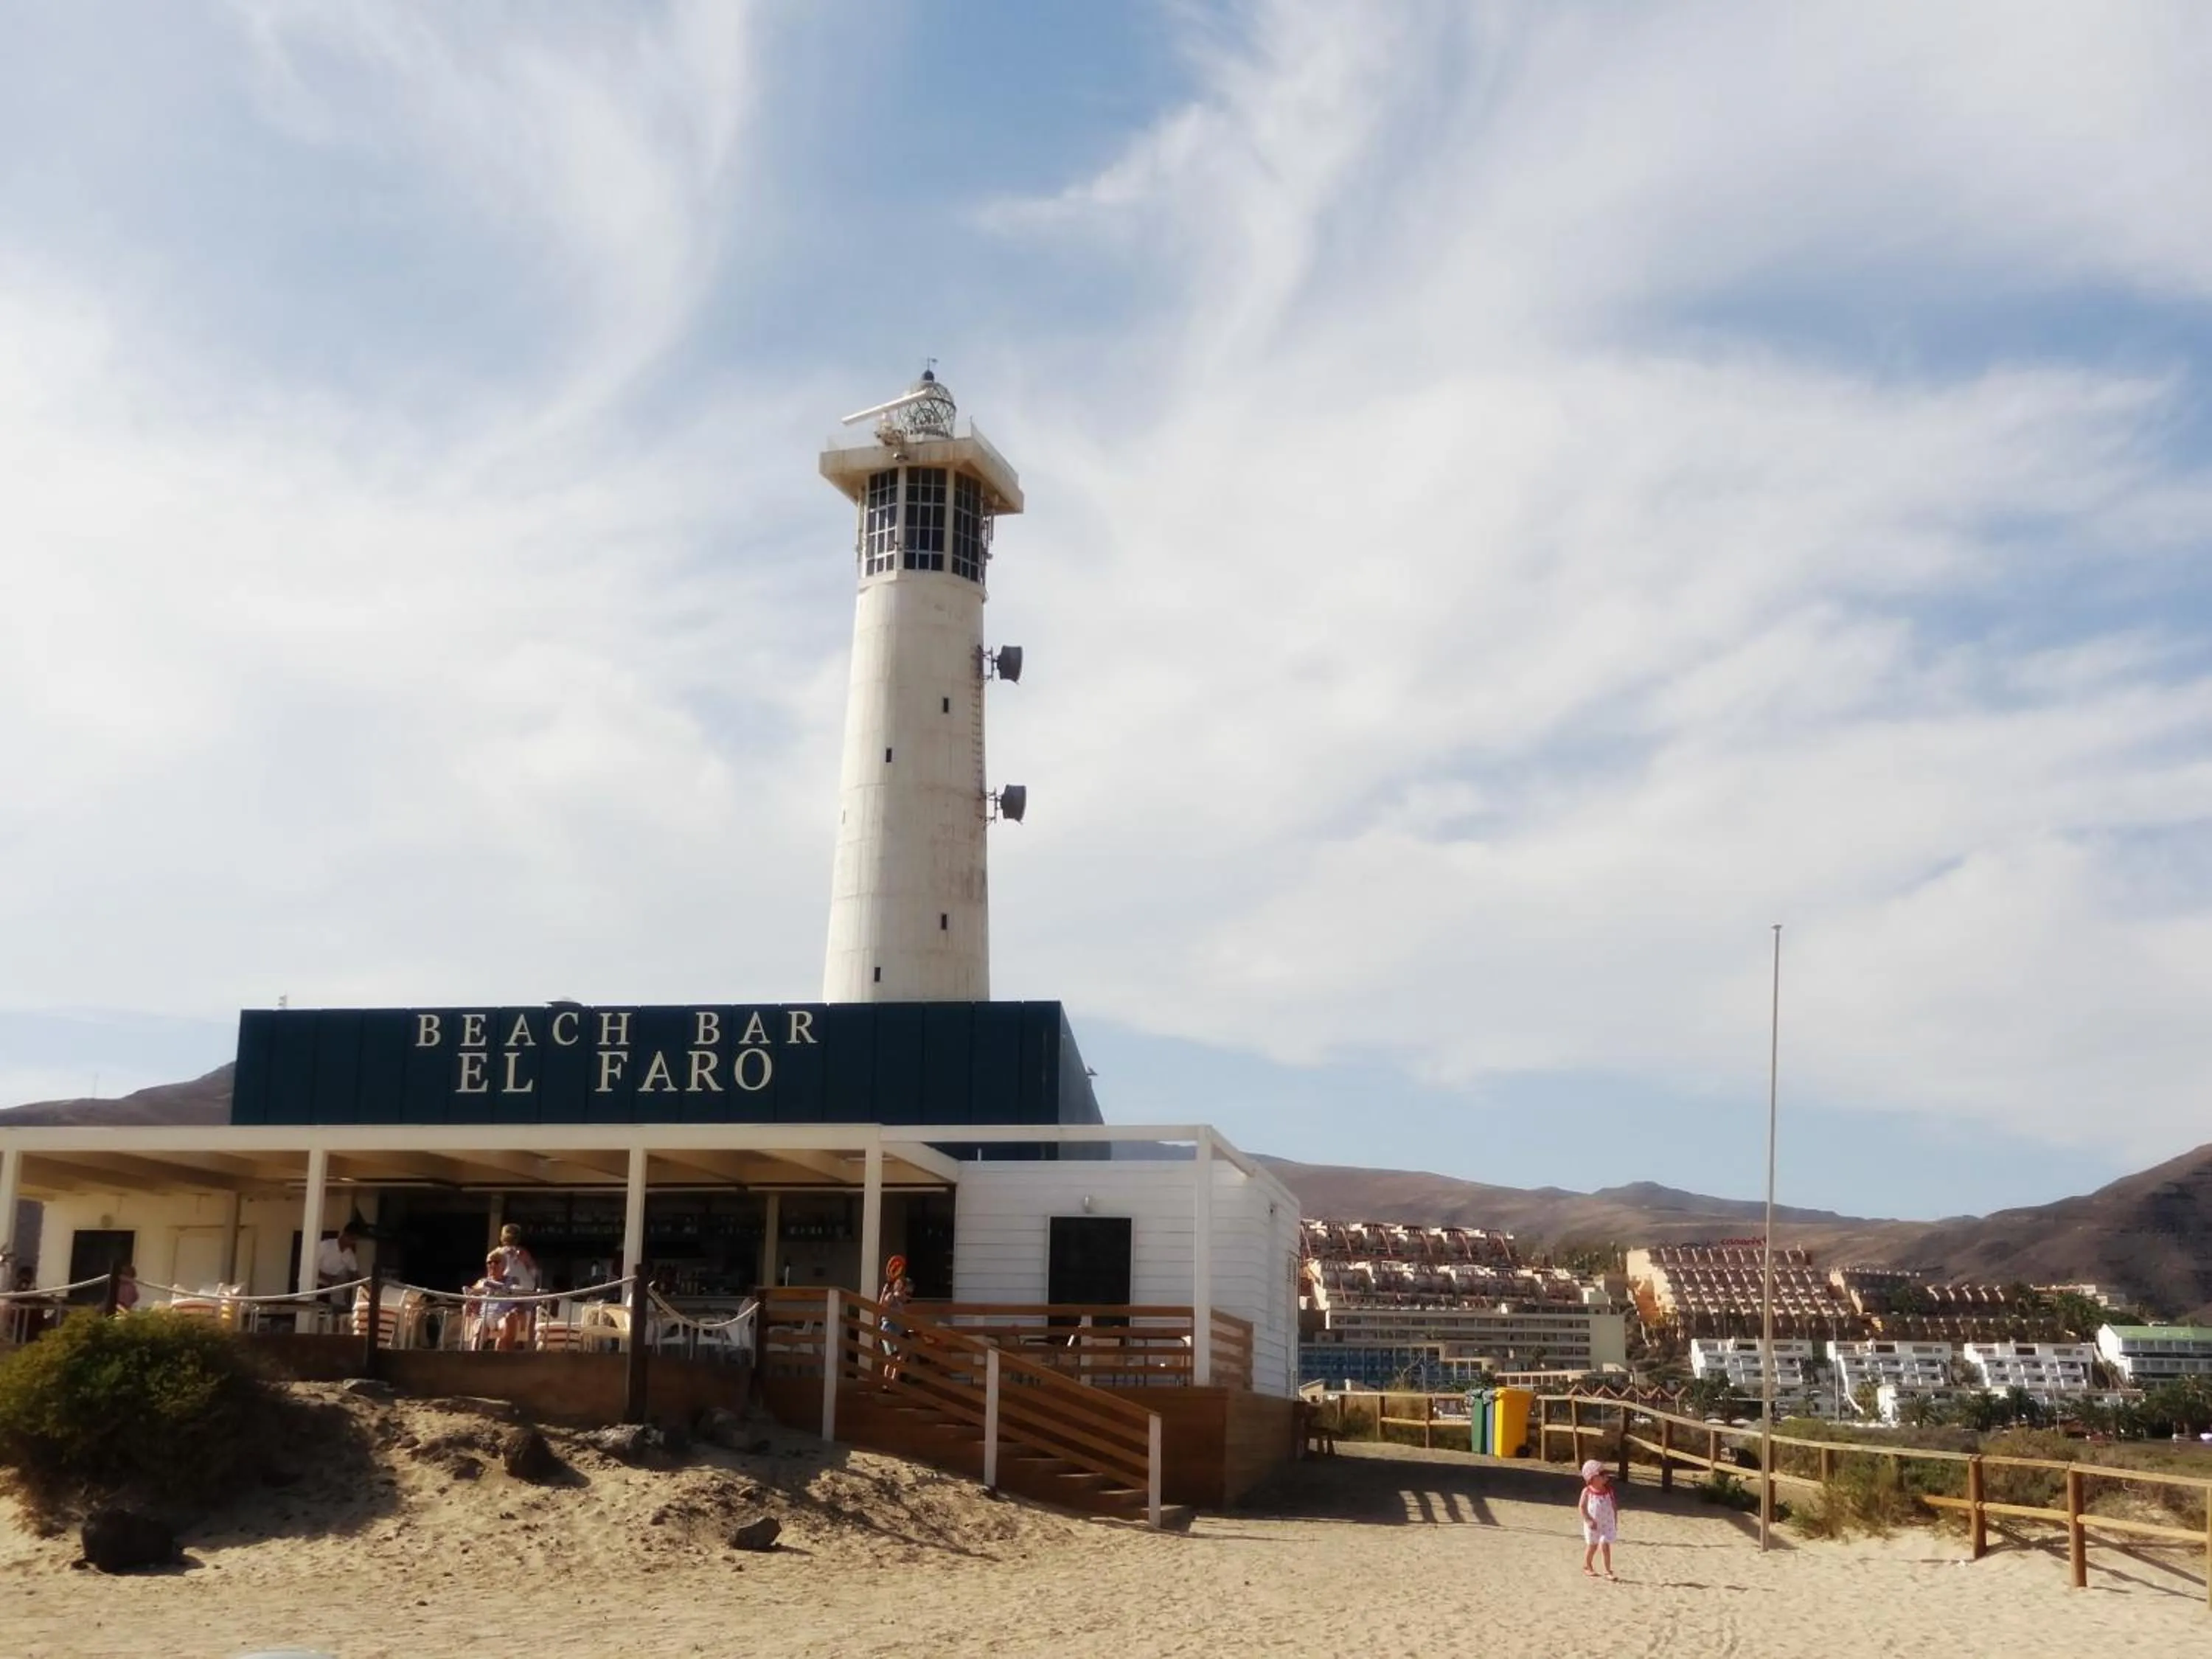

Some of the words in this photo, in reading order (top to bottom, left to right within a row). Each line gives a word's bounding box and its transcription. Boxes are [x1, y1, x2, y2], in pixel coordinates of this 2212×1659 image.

[416, 1012, 631, 1046] BEACH
[695, 1011, 817, 1045] BAR
[456, 1052, 532, 1092] EL
[596, 1048, 772, 1092] FARO
